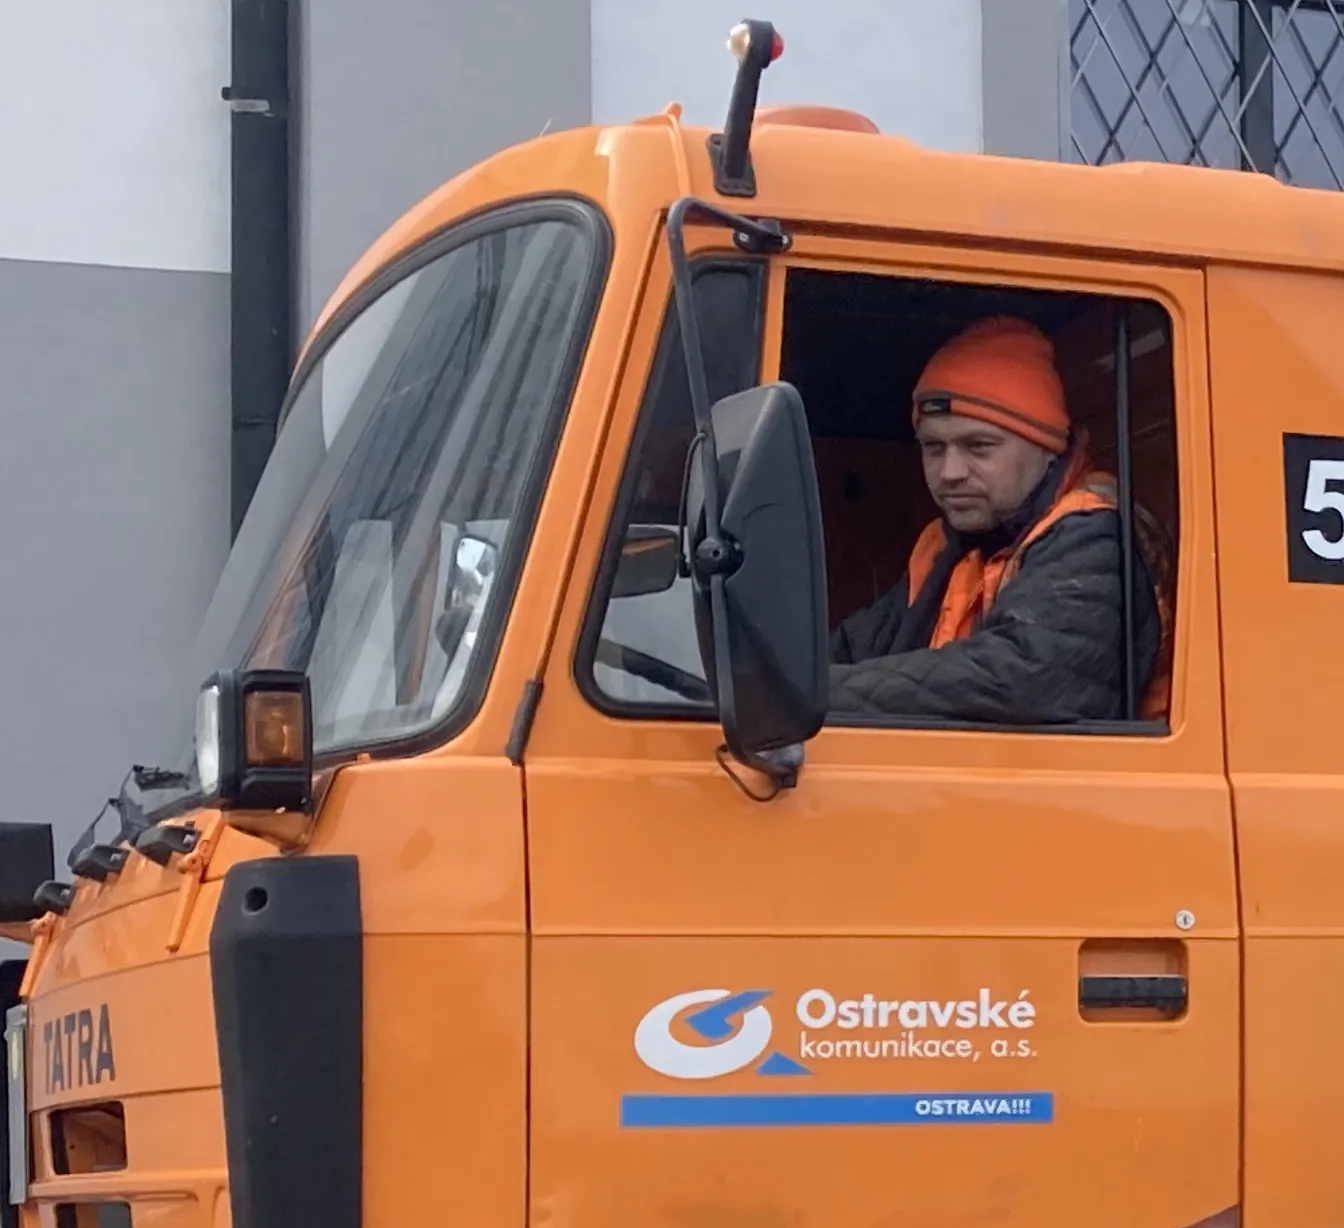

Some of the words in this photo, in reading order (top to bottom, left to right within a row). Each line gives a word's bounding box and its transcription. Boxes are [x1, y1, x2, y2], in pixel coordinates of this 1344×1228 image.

[796, 988, 1036, 1029] Ostravské
[44, 1003, 116, 1096] TATRA
[800, 1030, 981, 1062] komunikace,
[991, 1038, 1039, 1059] a.s.
[915, 1098, 1032, 1116] OSTRAVA!!!
